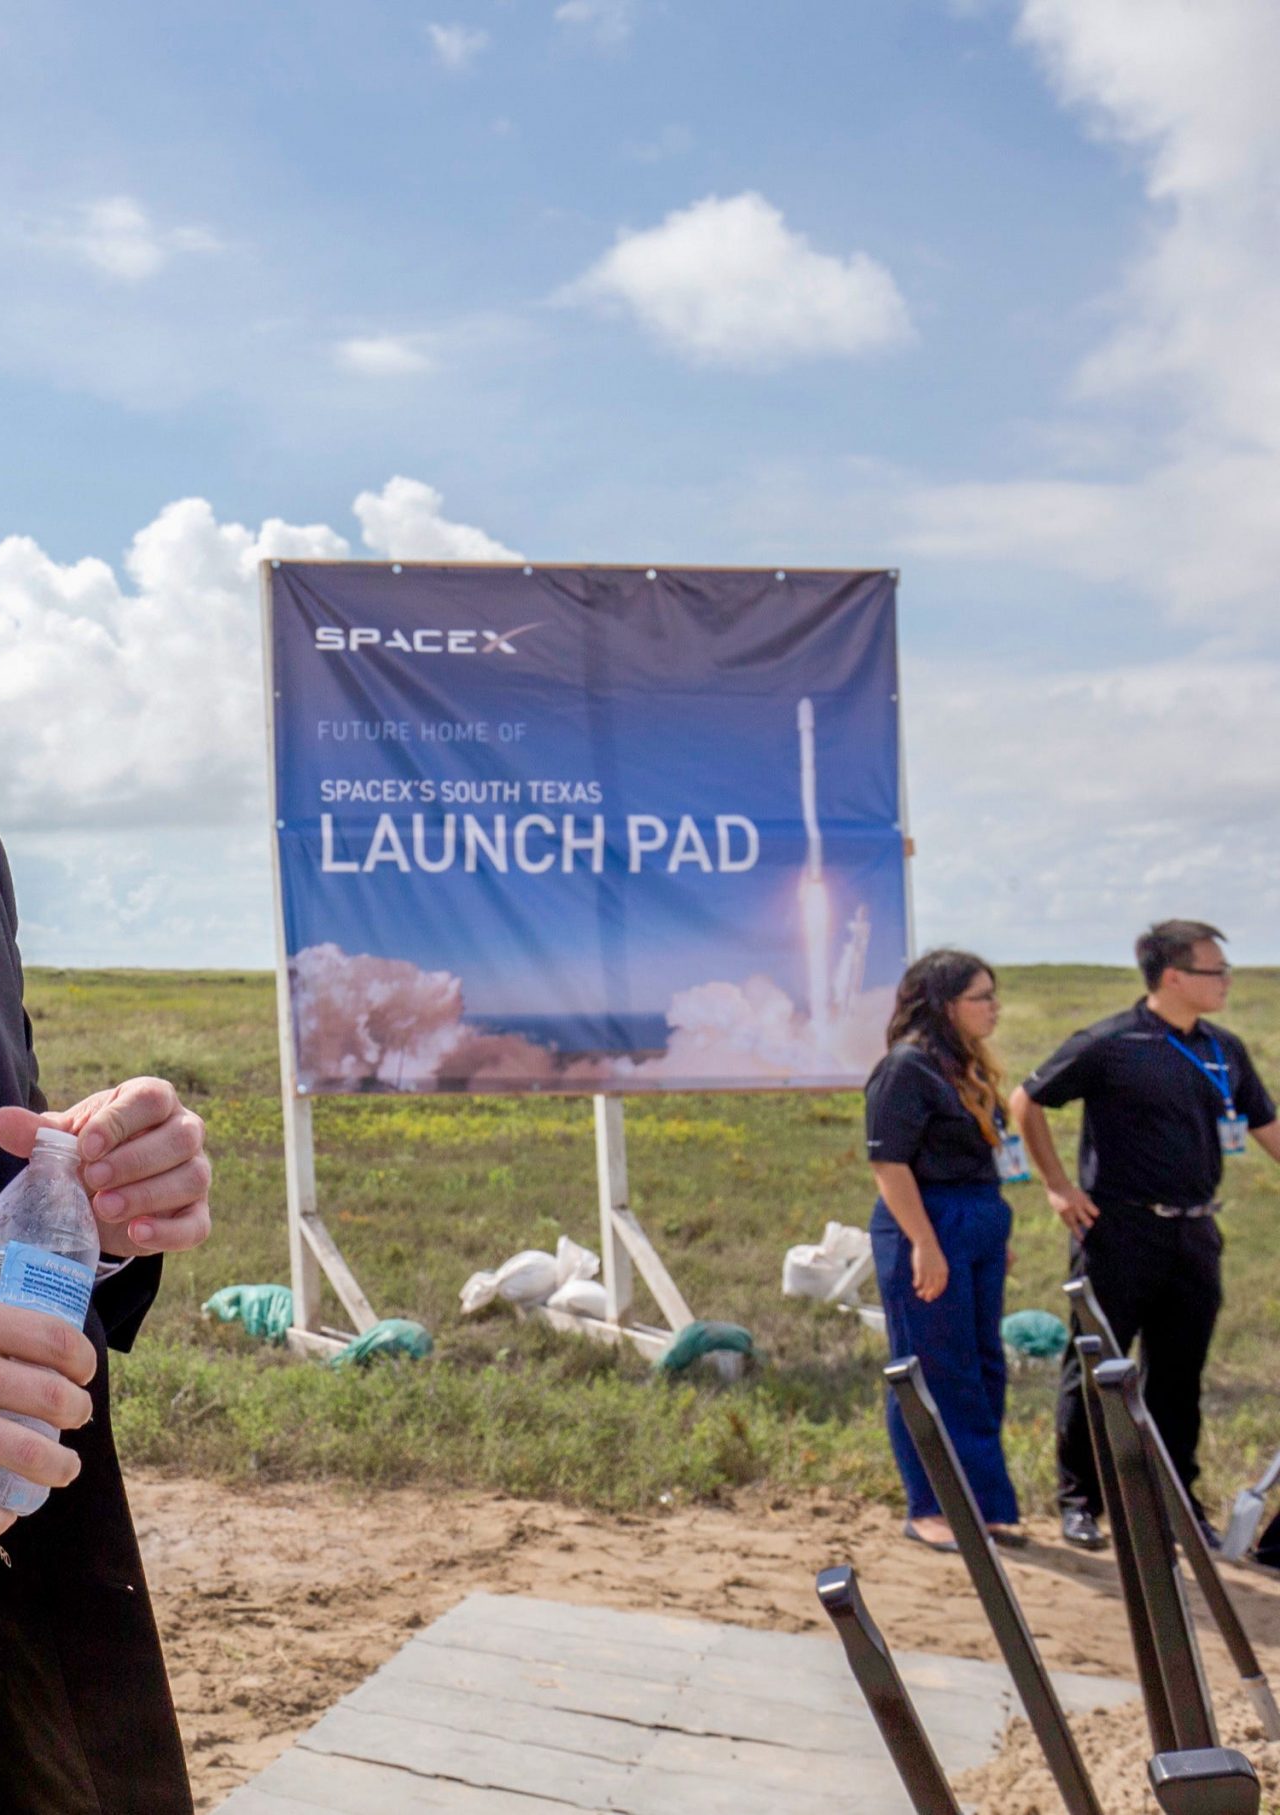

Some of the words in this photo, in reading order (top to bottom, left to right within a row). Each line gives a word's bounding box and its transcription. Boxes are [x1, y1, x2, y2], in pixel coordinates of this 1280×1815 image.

[315, 621, 544, 654] SPACEX
[318, 720, 410, 742] FUTURE
[421, 721, 489, 742] HOME
[498, 723, 528, 742] OF
[320, 779, 436, 802] SPACEX'S
[441, 780, 520, 803] SOUTH
[528, 781, 603, 804] TEXAS
[320, 812, 605, 874] LAUNCH
[627, 813, 760, 874] PAD
